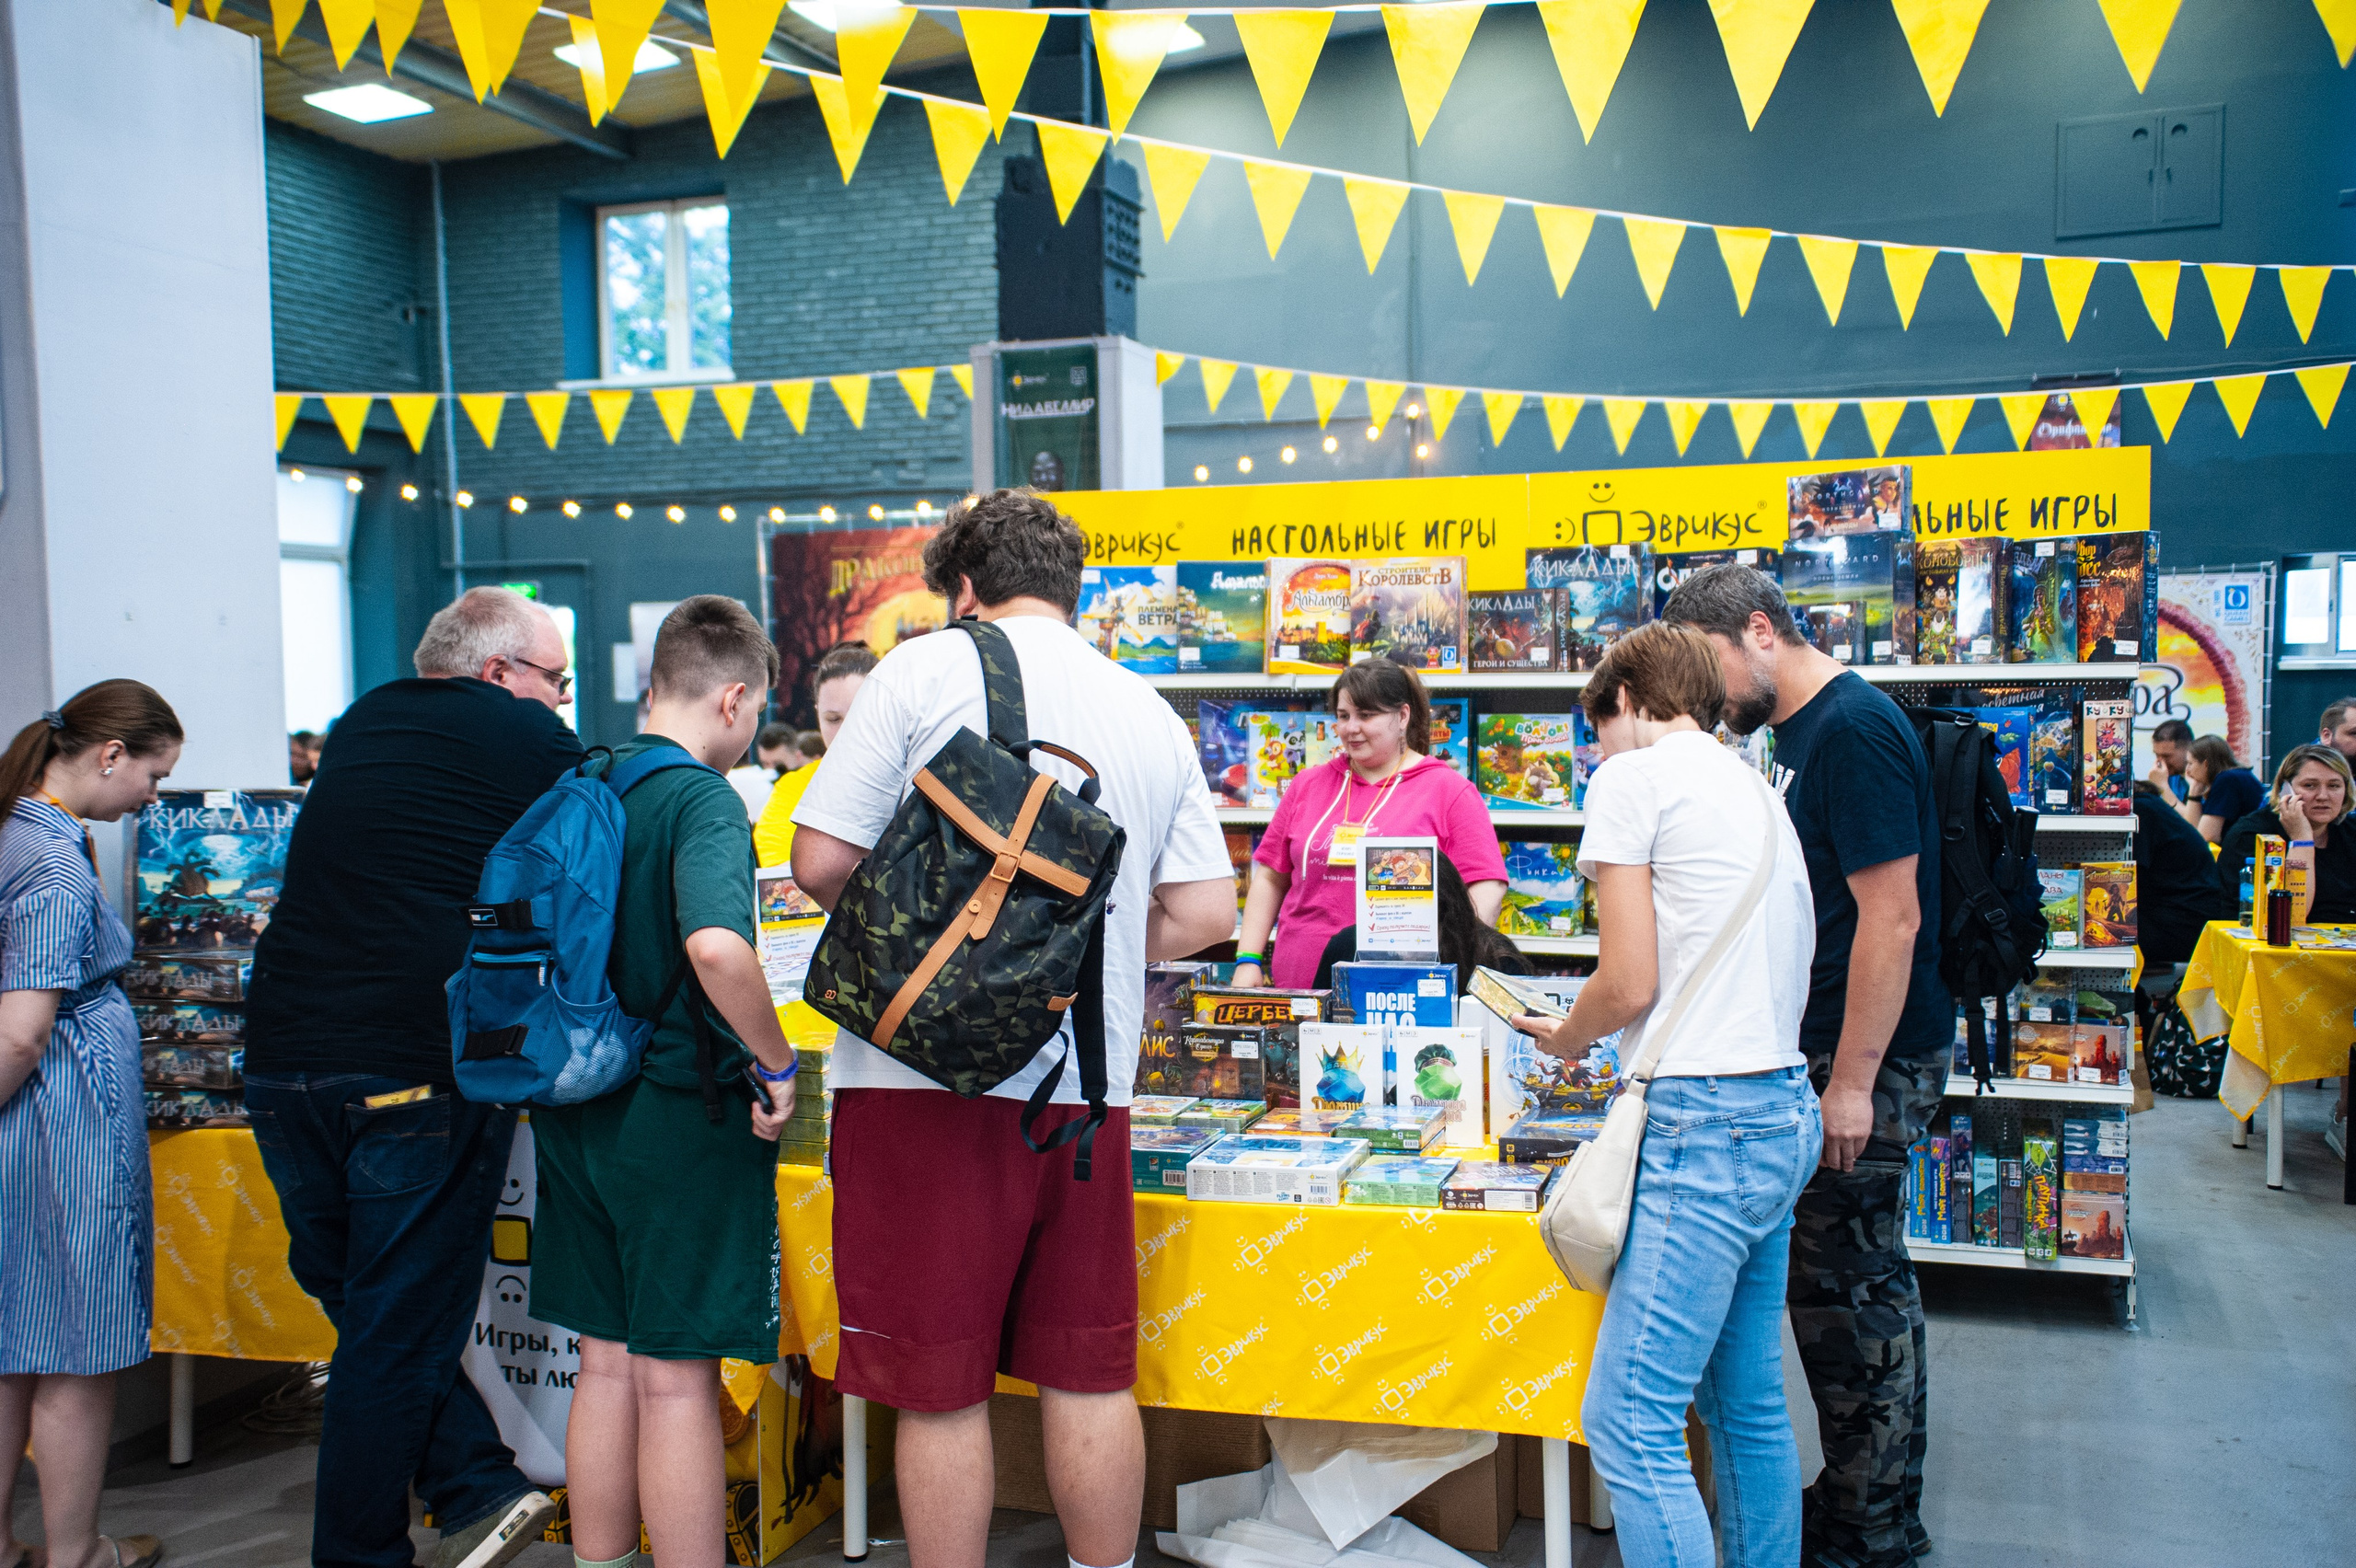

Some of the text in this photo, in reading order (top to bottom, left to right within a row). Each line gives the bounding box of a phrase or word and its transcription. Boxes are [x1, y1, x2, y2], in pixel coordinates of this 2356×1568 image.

[1629, 509, 1763, 547] Эврикус
[2030, 493, 2117, 531] ИГРЫ
[1231, 517, 1496, 555] НАСТОЛЬНЫЕ ИГРЫ
[1357, 567, 1452, 587] КОРОЛЕВСТВ
[1533, 556, 1632, 579] КИКЛАДЫ
[1473, 660, 1498, 668] ГЕРОИ
[1366, 991, 1416, 1012] ПОСЛЕ
[1142, 1215, 1192, 1257] Эврикус
[1257, 1212, 1310, 1255] Эврикус
[1319, 1245, 1373, 1290] Эврикус
[1441, 1243, 1498, 1288] Эврикус
[1156, 1287, 1207, 1331] Эврикус
[1507, 1280, 1565, 1324] Эврикус
[475, 1321, 558, 1358] Игры,
[1218, 1321, 1269, 1365] Эврикус
[1335, 1321, 1389, 1365] Эврикус
[500, 1365, 538, 1386] ты
[1398, 1355, 1453, 1400] Эврикус
[1524, 1355, 1578, 1400] Эврикус
